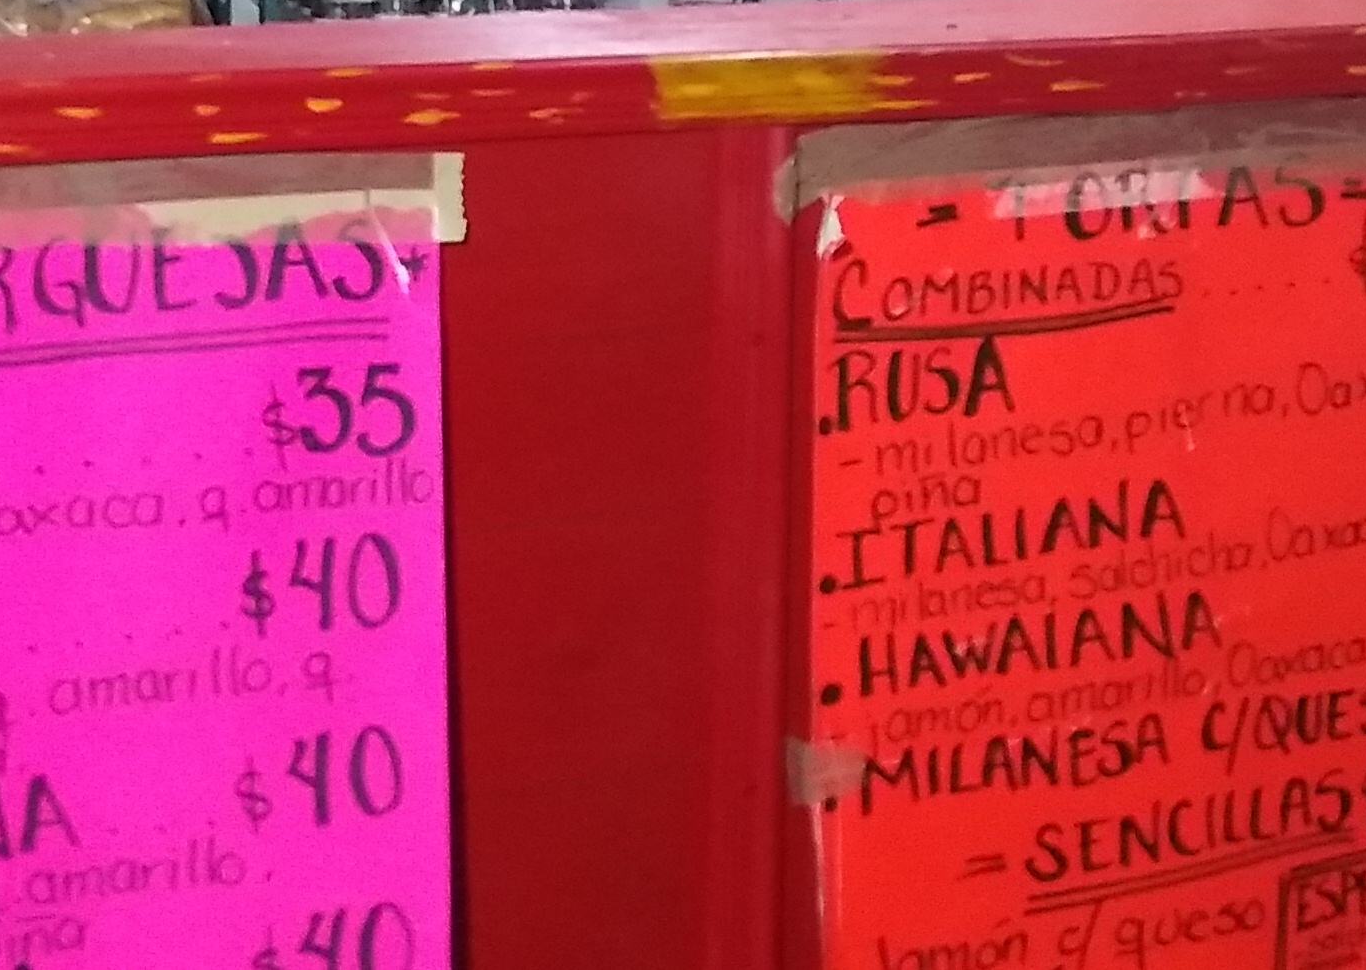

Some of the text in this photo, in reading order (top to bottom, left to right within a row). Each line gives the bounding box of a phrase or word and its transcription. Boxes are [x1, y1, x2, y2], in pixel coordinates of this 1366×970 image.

[833, 258, 1182, 331] COMBINADAS
[262, 362, 417, 471] $35
[832, 334, 1015, 432] RUSA
[242, 533, 401, 638] $40
[835, 479, 1186, 591] ITALIANA
[859, 590, 1222, 697] HAWAIANA
[237, 724, 403, 832] $40
[861, 713, 1169, 815] MILANESA
[1024, 768, 1353, 882] SENCILLAS
